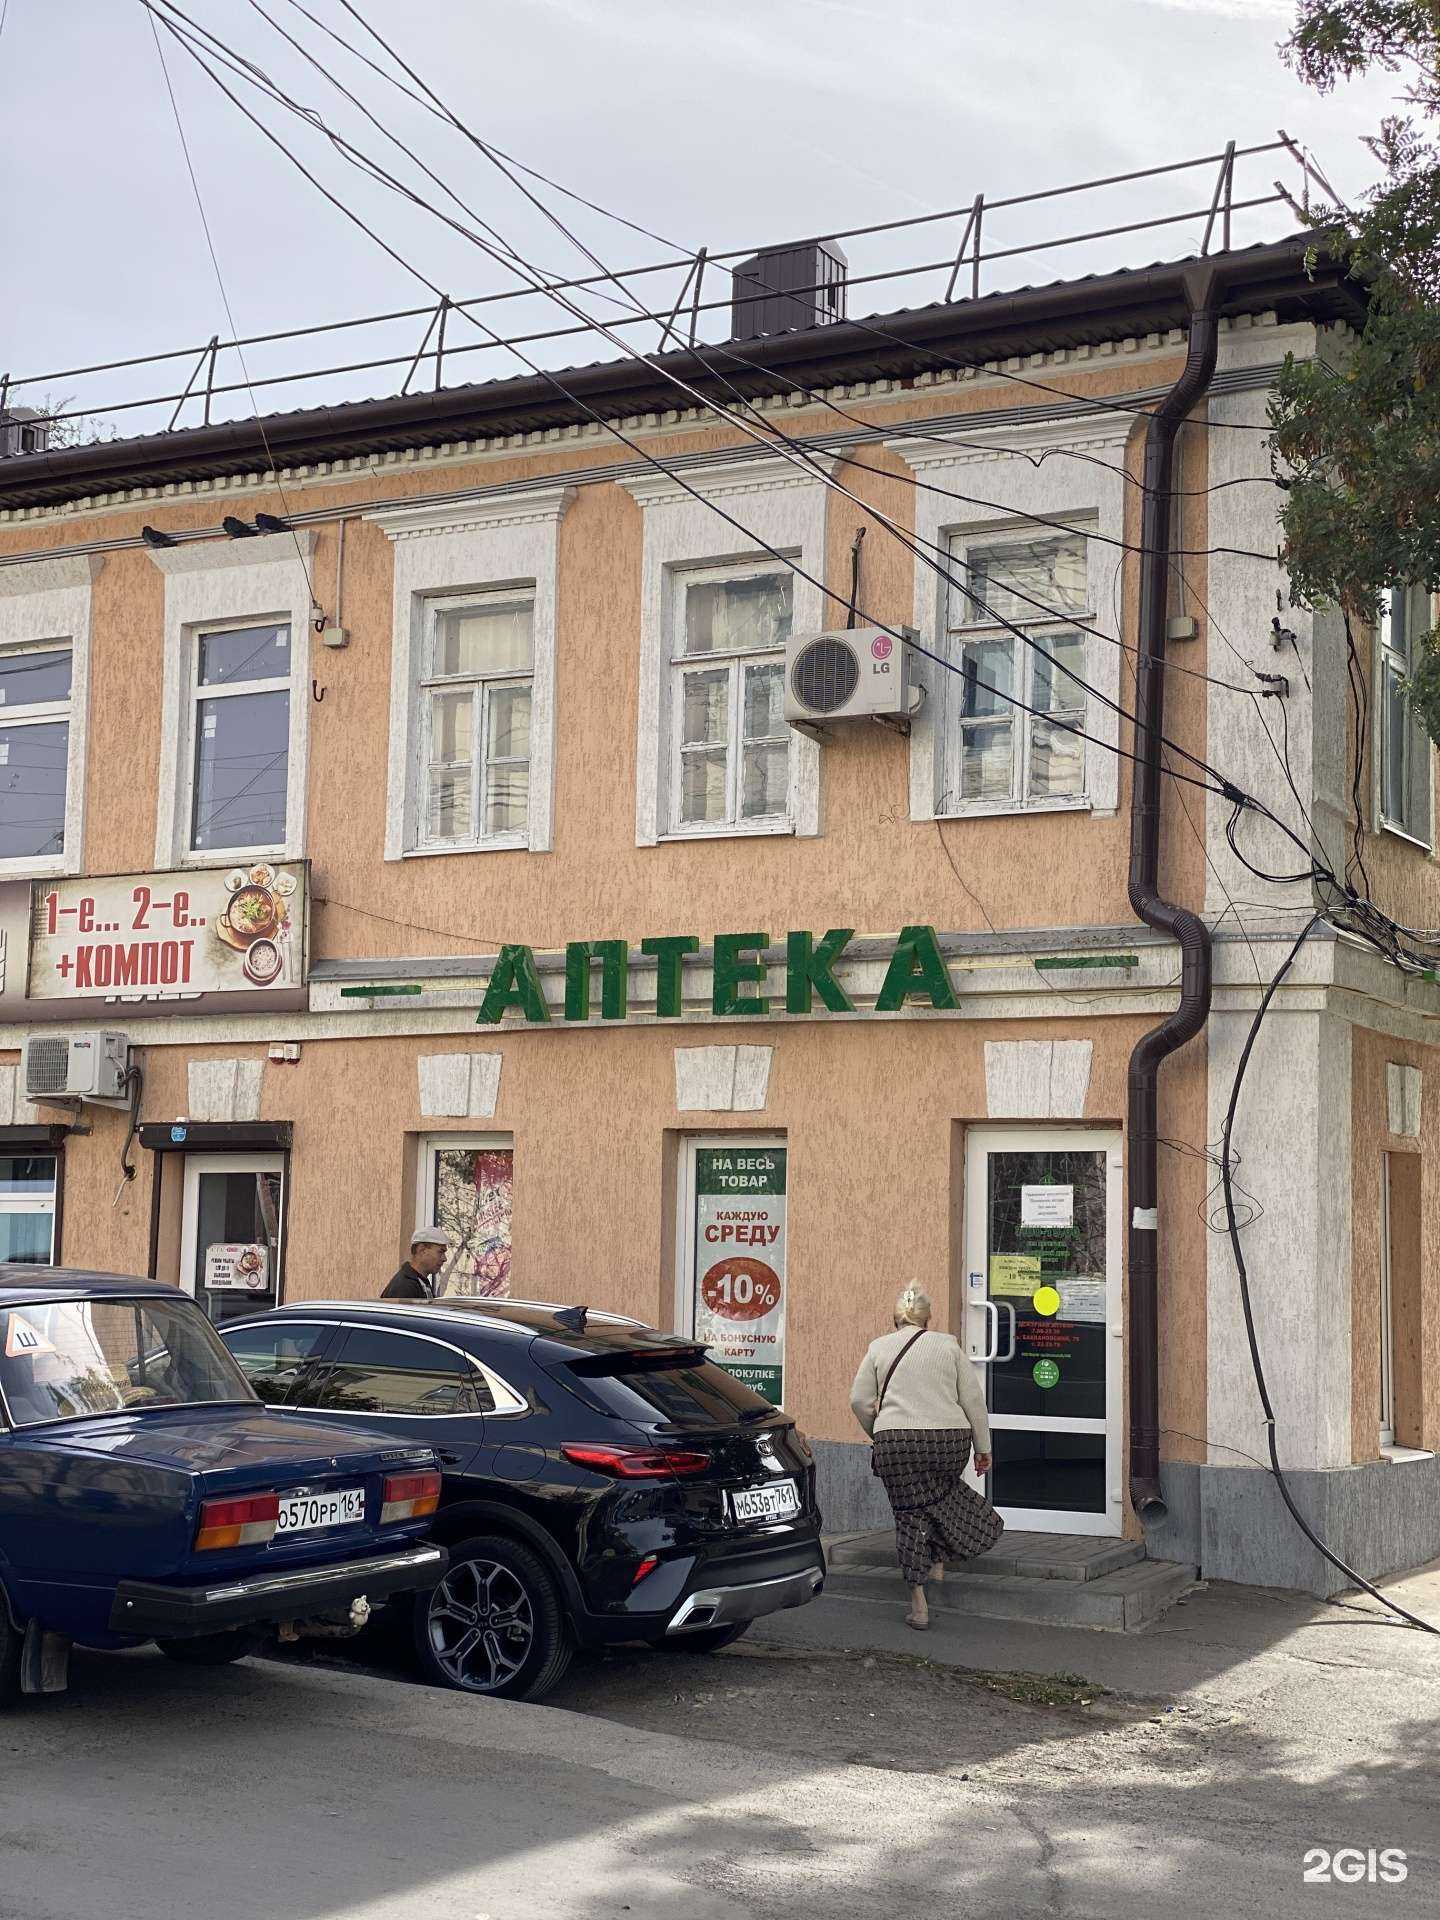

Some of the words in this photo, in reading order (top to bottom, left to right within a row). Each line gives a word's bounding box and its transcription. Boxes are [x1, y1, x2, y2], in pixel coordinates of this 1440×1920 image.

[872, 662, 890, 675] LG
[56, 940, 195, 988] +КОМПОТ
[476, 925, 961, 1025] АПТЕКА
[712, 1158, 732, 1170] НА
[737, 1157, 775, 1170] ВЕСЬ
[719, 1175, 768, 1187] ТОВАР
[716, 1210, 769, 1222] КАЖДУЮ
[705, 1224, 780, 1246] СРЕДУ
[707, 1273, 775, 1305] -10%
[703, 1333, 718, 1342] НА
[720, 1333, 776, 1343] БОНУСНУЮ
[724, 1348, 755, 1357] КАРТУ
[727, 1368, 775, 1379] ПОКУПКЕ
[341, 1491, 362, 1513] 161
[775, 1486, 793, 1505] 761
